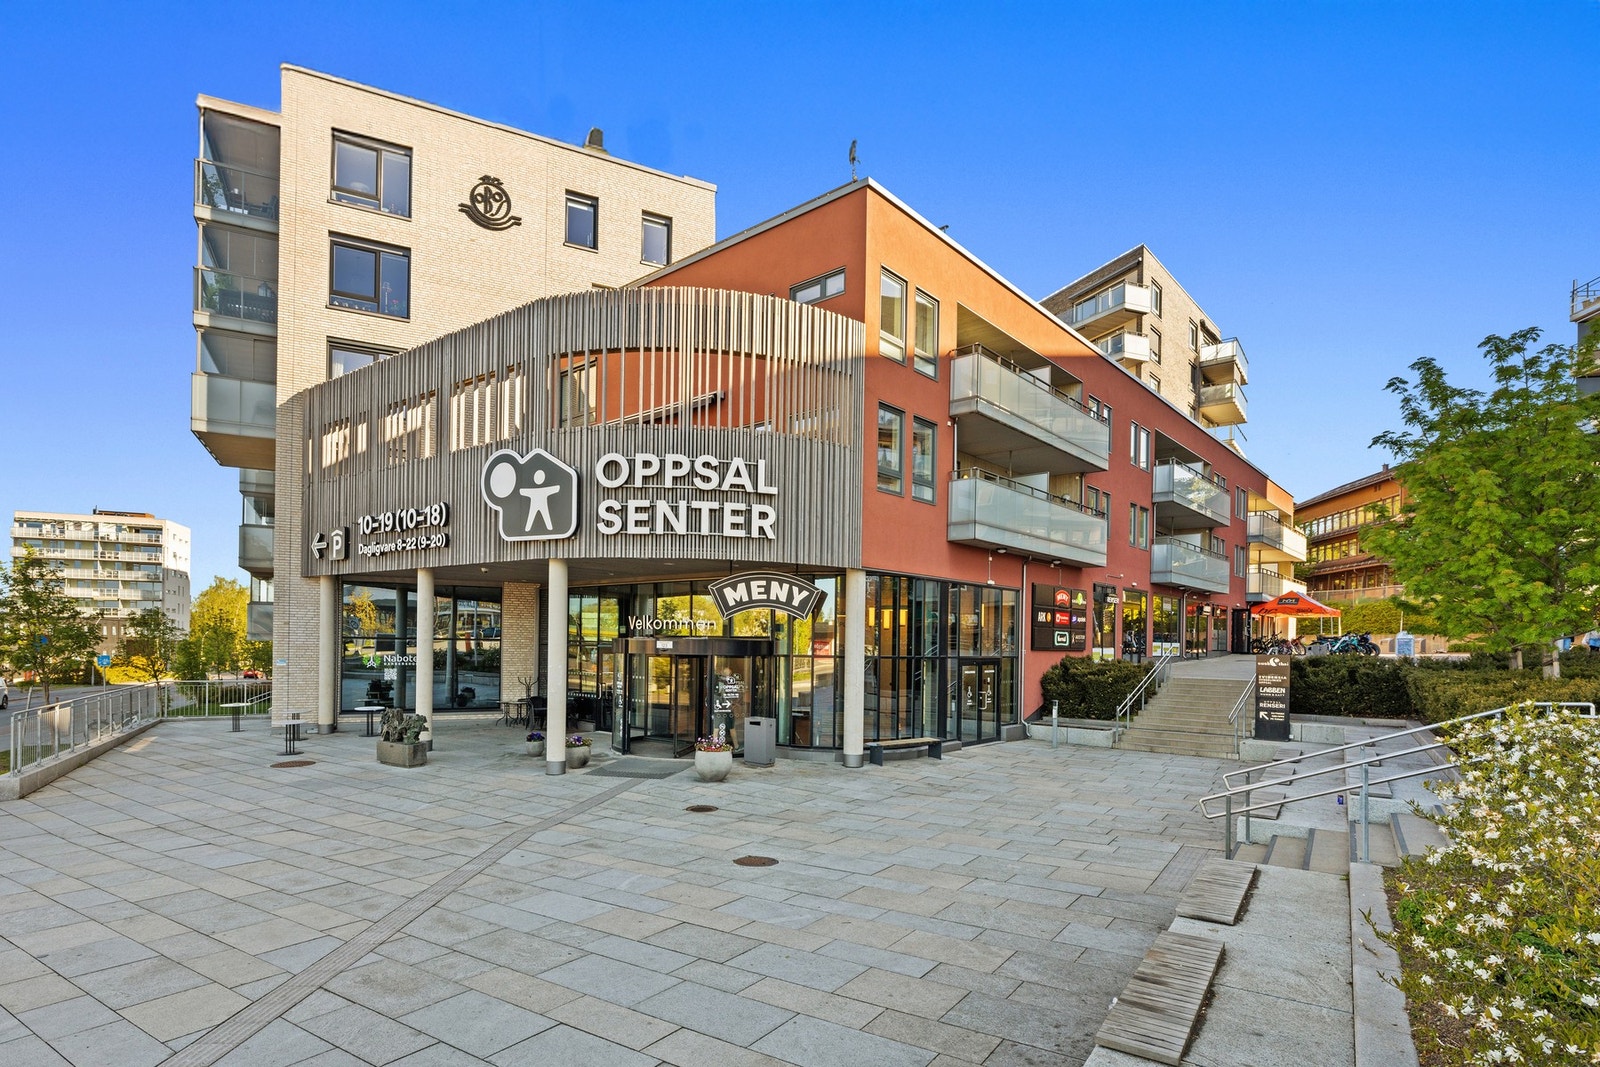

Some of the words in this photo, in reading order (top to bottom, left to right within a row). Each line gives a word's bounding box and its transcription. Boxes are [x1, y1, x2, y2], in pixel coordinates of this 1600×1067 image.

[595, 452, 778, 495] OPPSAL
[357, 511, 394, 535] 10-19
[396, 501, 447, 532] (10-18)
[596, 499, 776, 540] SENTER
[358, 542, 396, 557] Dagligvare
[396, 536, 417, 551] 8-22
[417, 532, 446, 550] (9-20)
[722, 580, 810, 607] MENY
[628, 615, 717, 631] Velkommen
